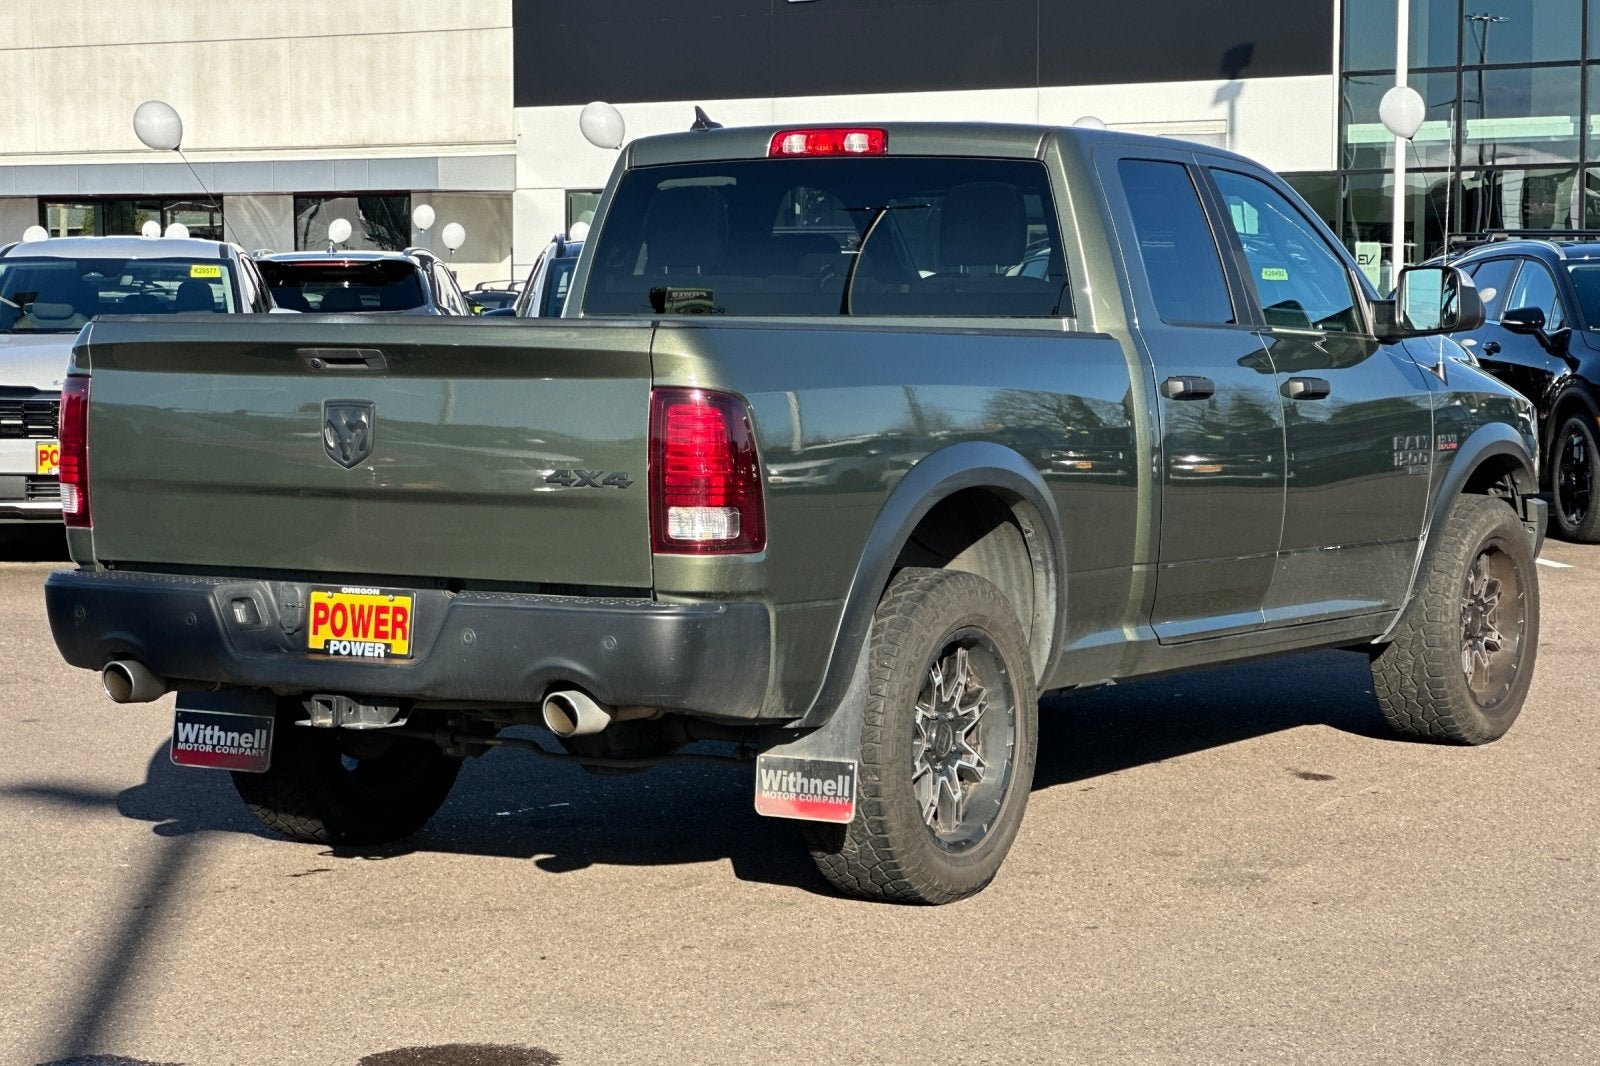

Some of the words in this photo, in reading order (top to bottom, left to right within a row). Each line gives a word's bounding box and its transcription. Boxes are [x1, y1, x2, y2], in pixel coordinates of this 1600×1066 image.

[341, 587, 380, 595] OREGON
[312, 602, 408, 640] POWER
[329, 640, 385, 657] POWER
[177, 722, 267, 749] Withnell
[177, 742, 213, 753] MOTOR
[215, 745, 266, 757] COMPANY
[760, 768, 850, 797] Withnell
[761, 790, 797, 801] MOTOR
[799, 793, 850, 806] COMPANY
